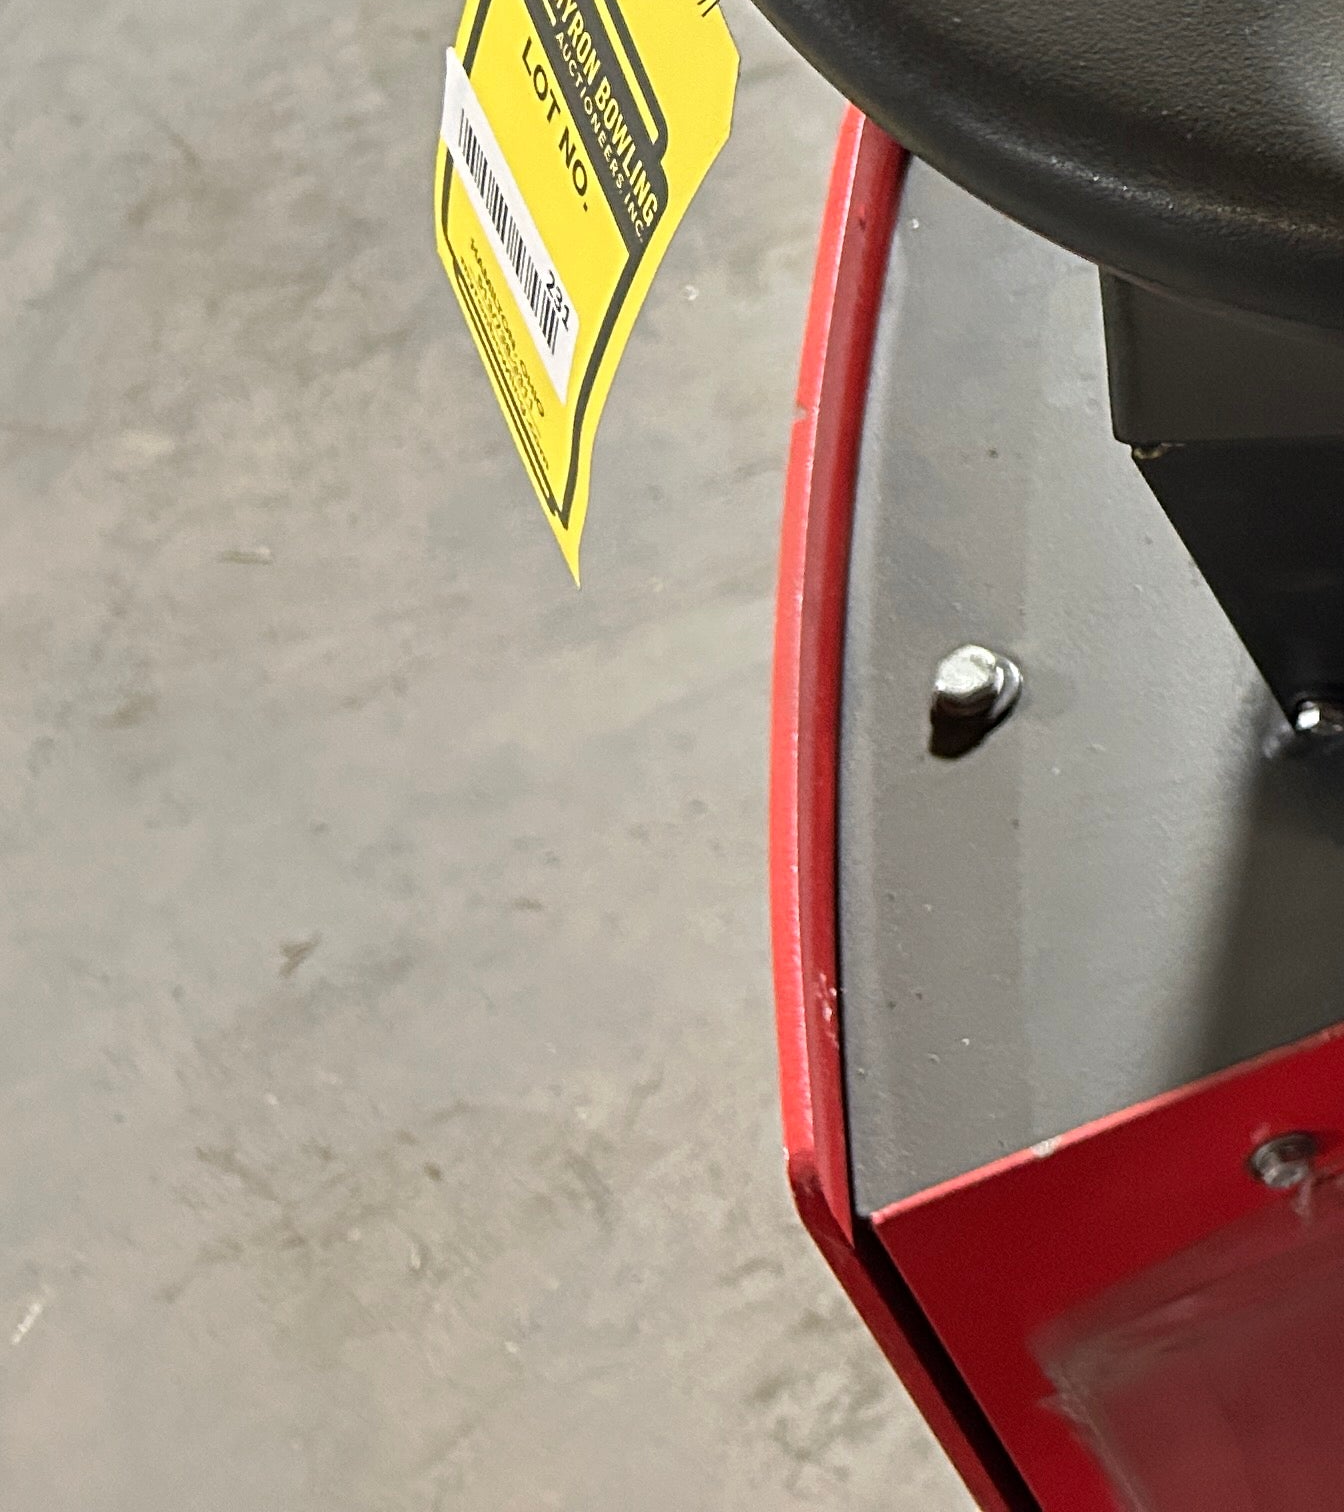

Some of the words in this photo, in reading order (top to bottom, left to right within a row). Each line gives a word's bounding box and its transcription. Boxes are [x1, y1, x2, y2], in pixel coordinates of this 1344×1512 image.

[521, 34, 560, 134] LOT
[558, 122, 593, 213] NO.
[594, 69, 658, 233] BOWLING
[623, 189, 645, 245] INC.
[545, 266, 572, 334] 231
